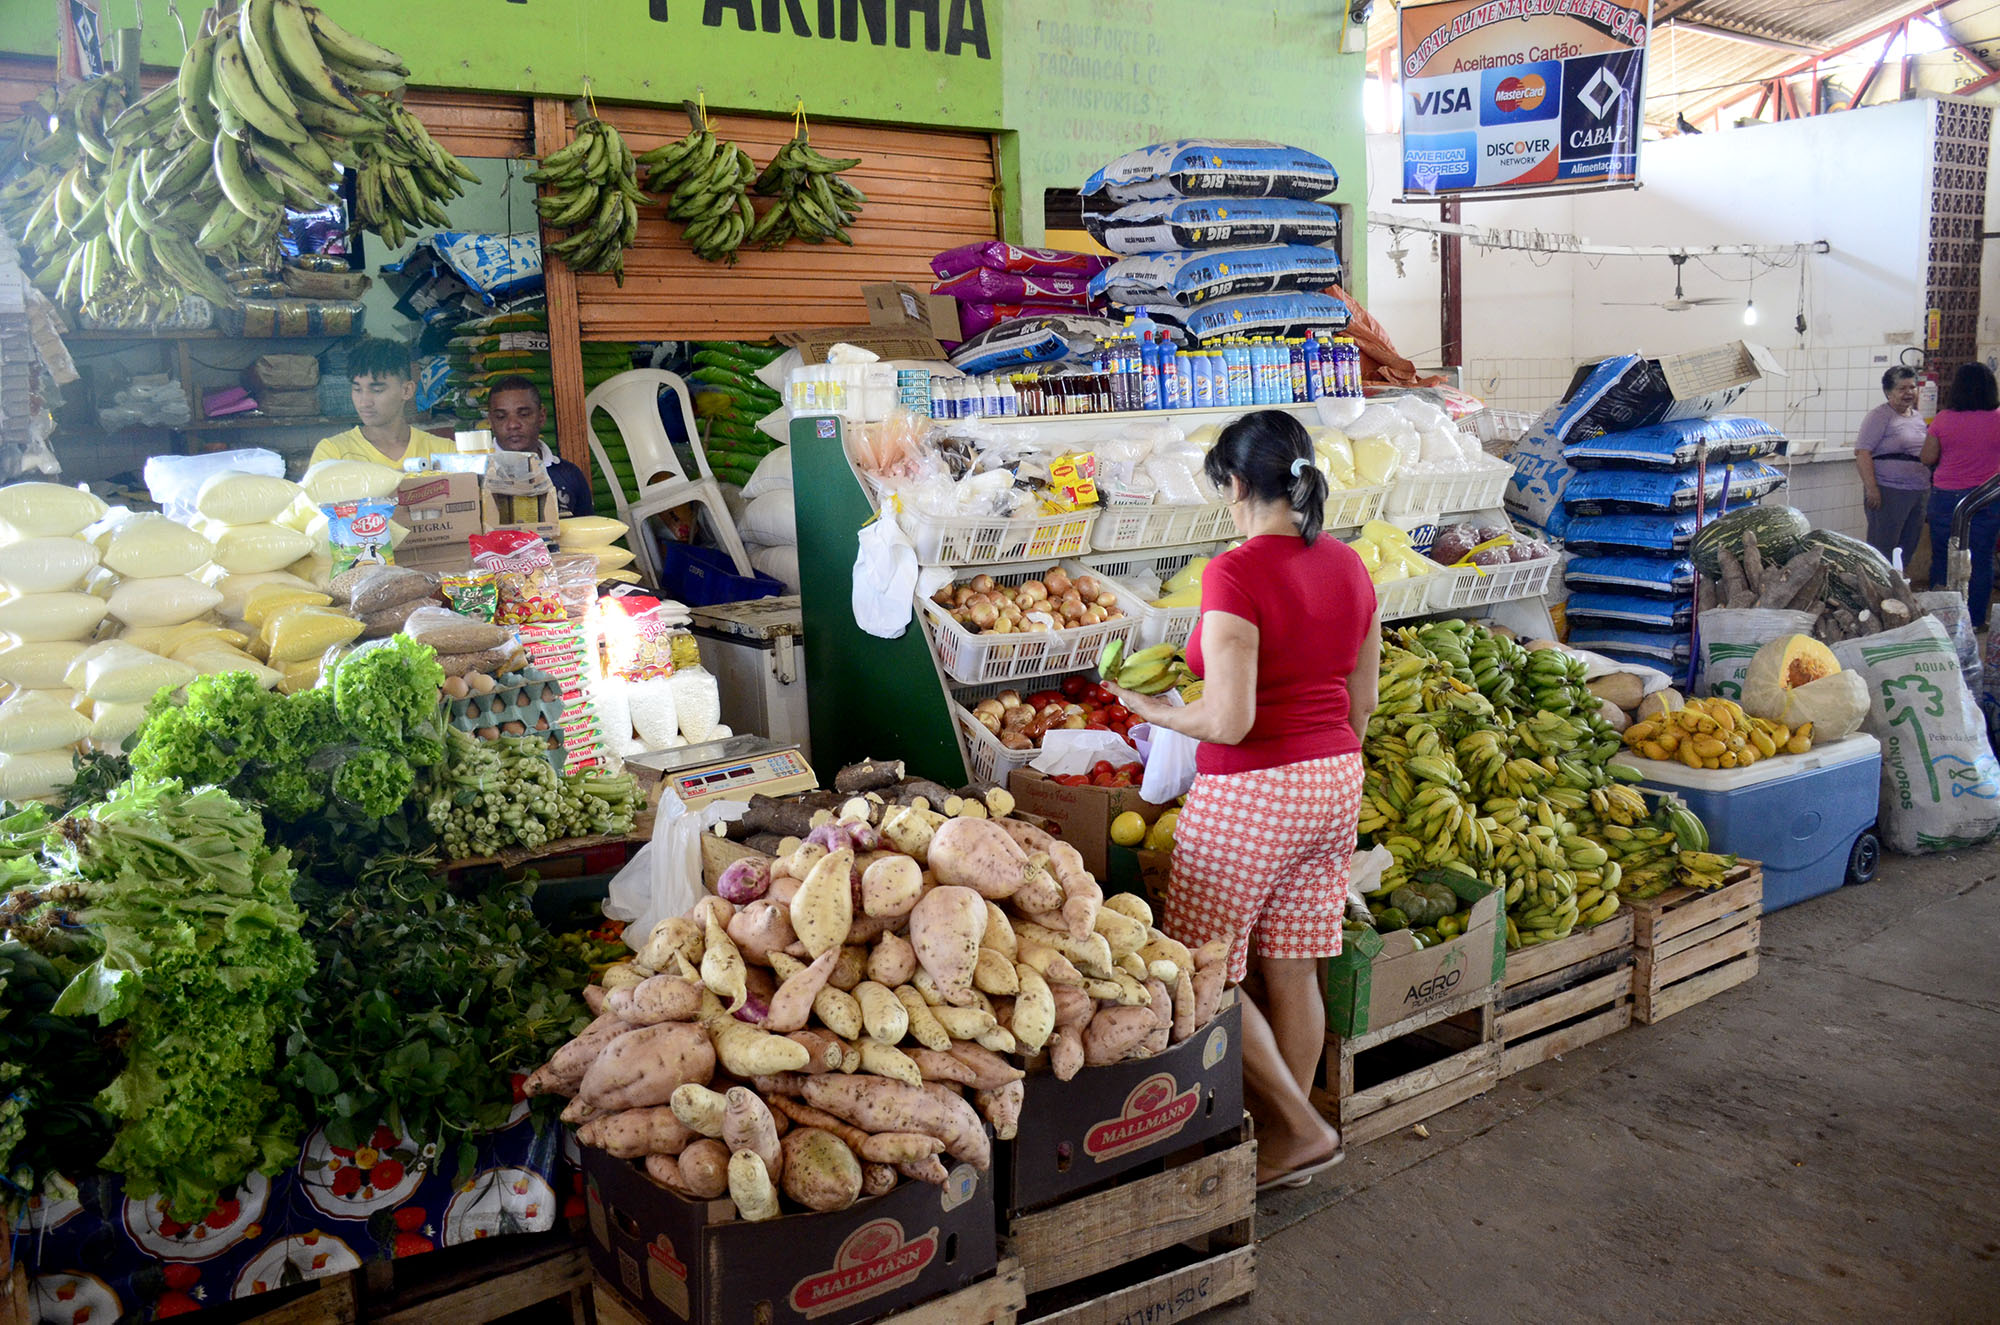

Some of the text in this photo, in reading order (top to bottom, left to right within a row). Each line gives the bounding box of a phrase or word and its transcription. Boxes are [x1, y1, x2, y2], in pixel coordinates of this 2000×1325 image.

[649, 0, 992, 60] INHA
[1405, 25, 1450, 78] CABAL
[1556, 0, 1568, 14] E
[1568, 0, 1647, 45] REFEIÇÃO
[1453, 42, 1582, 73] Aceitamos Cartão:
[1952, 46, 1990, 63] Ste
[1408, 87, 1472, 116] VISA
[1495, 85, 1545, 102] MasterCard
[1569, 125, 1628, 149] CABAL
[1405, 149, 1466, 162] AMERICAN
[1486, 138, 1550, 157] DISCOVER
[1417, 162, 1469, 175] EXPRESS
[1500, 156, 1536, 166] NETWORK
[1571, 160, 1622, 174] Alimentação
[1202, 174, 1226, 188] BIG
[1207, 227, 1231, 241] BIG
[1209, 281, 1233, 298] BIG
[405, 521, 453, 534] TEGRAL
[529, 627, 571, 638] Barralcool
[530, 641, 571, 655] Barralcool
[534, 652, 574, 667] Barralcool
[1914, 661, 1947, 674] AQUA
[564, 735, 590, 748] ralcool
[1403, 969, 1460, 1004] AGRO
[1411, 988, 1451, 1009] PLANTEC
[1101, 1101, 1189, 1145] MALLMANN
[811, 1246, 921, 1299] MALLMANN
